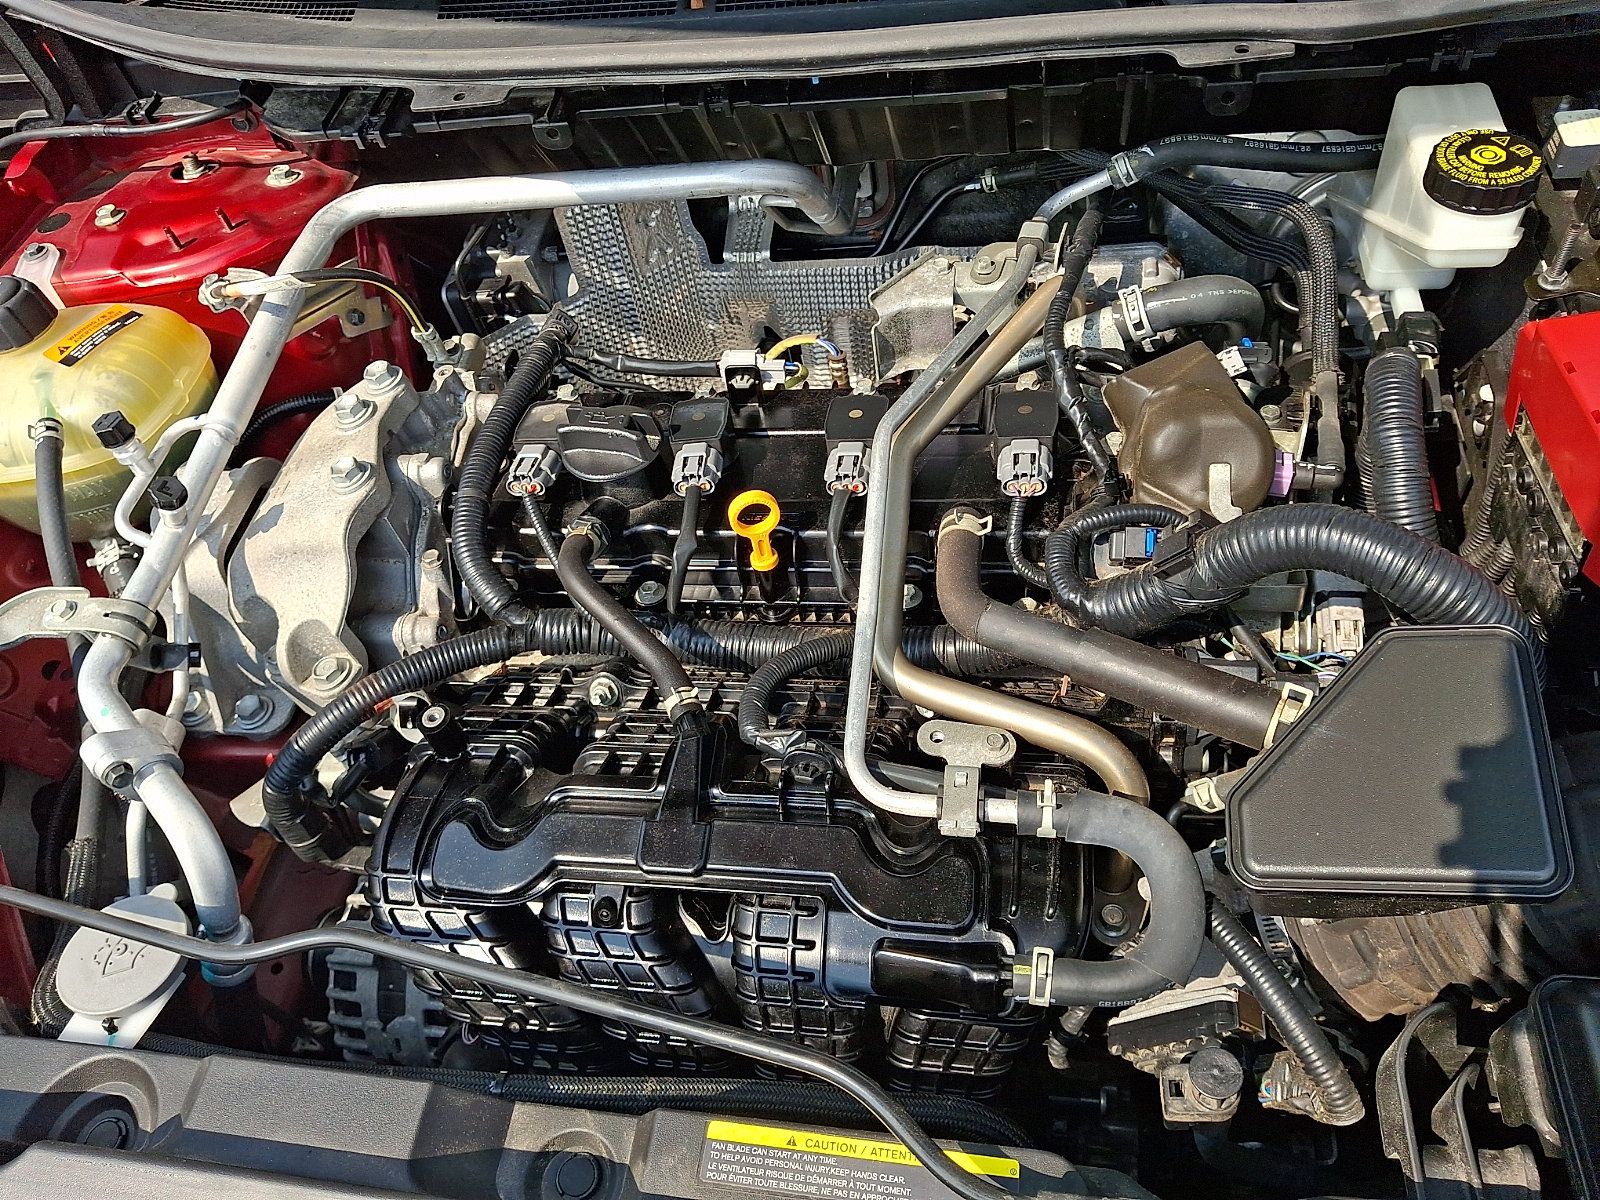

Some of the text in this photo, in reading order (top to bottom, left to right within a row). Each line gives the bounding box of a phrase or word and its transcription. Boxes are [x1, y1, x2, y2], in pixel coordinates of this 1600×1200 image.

[1448, 169, 1468, 180] FLUID
[1468, 176, 1488, 184] FROM
[1497, 174, 1526, 184] SEALED
[1458, 166, 1487, 177] BEFORE
[1488, 166, 1524, 178] REMOVING
[712, 1142, 726, 1150] FAN
[727, 1144, 751, 1154] BLADE
[752, 1147, 768, 1156] CAN
[769, 1150, 792, 1159] START
[802, 1154, 818, 1162] ANY
[820, 1156, 838, 1166] TIME.
[805, 1139, 857, 1154] CAUTION
[718, 1164, 765, 1176] VENTILATEUR
[766, 1170, 794, 1180] RISQUE
[806, 1174, 850, 1188] DÉMARRER
[848, 1179, 855, 1189] À
[856, 1182, 876, 1192] TOUT
[878, 1184, 912, 1196] MOMENT.
[722, 1152, 740, 1162] HELP
[742, 1156, 763, 1164] AVOID
[764, 1158, 804, 1170] PERSONAL
[851, 1170, 878, 1180] HANDS
[879, 1174, 906, 1184] CLEAR.
[706, 1172, 728, 1180] POUR
[728, 1172, 753, 1184] ÉVITER
[754, 1178, 778, 1188] TOUTE
[780, 1182, 820, 1194] BLESSURE,
[820, 1186, 832, 1196] NE
[832, 1189, 848, 1198] PAS
[850, 1191, 860, 1200] EN
